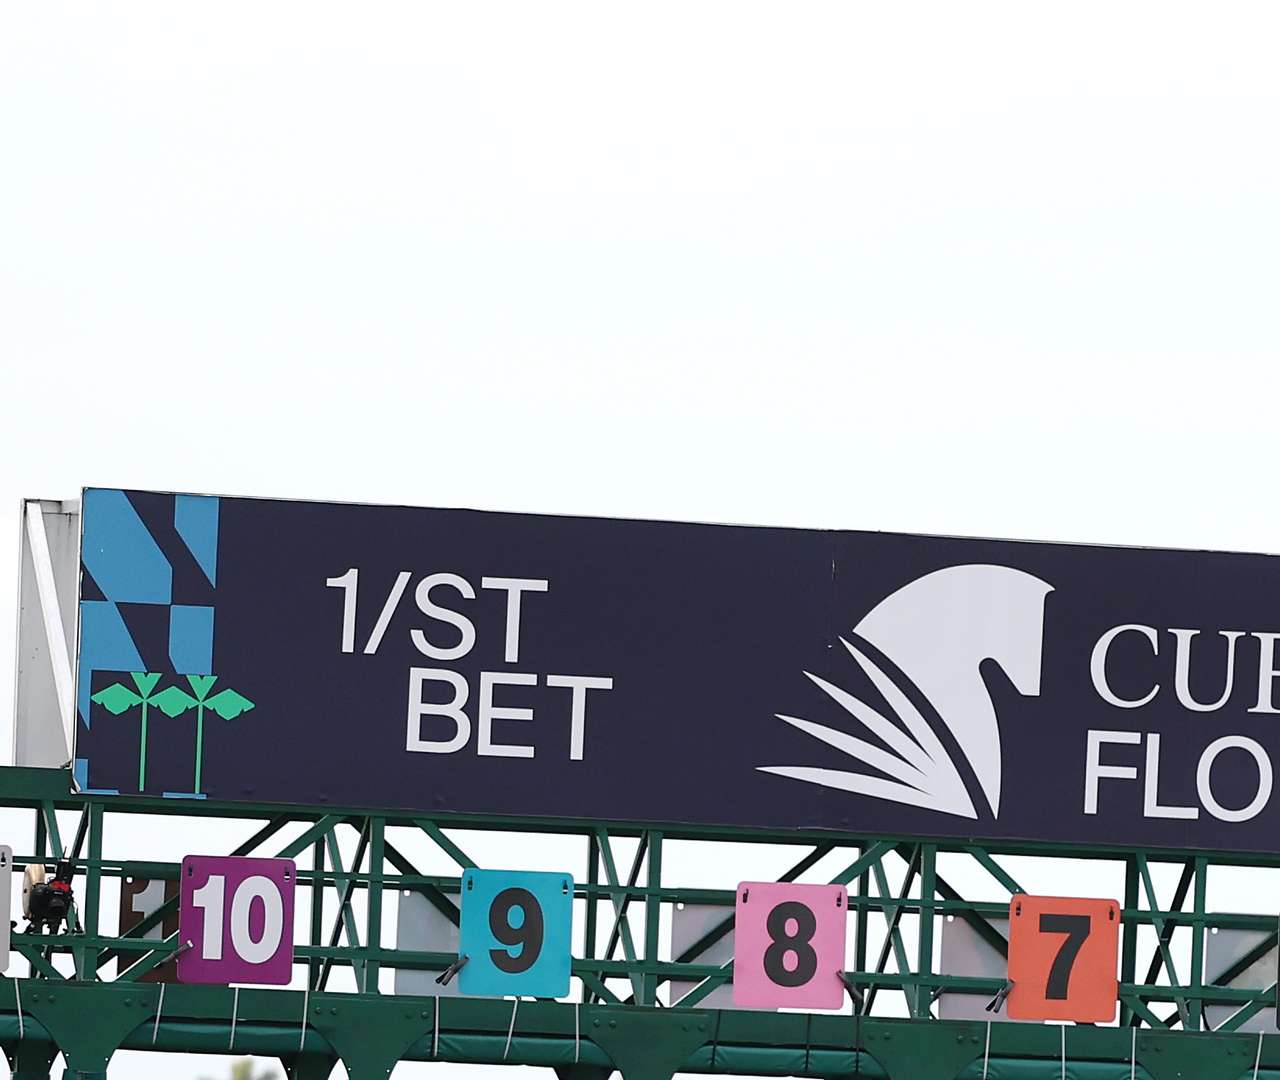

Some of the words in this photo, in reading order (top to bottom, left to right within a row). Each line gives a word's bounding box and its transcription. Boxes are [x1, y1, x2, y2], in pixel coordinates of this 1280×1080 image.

[327, 568, 549, 663] 1/ST
[405, 666, 613, 761] BET
[192, 874, 284, 964] 10
[488, 887, 544, 974] 9
[763, 901, 818, 988] 8
[1039, 913, 1091, 1000] 7
